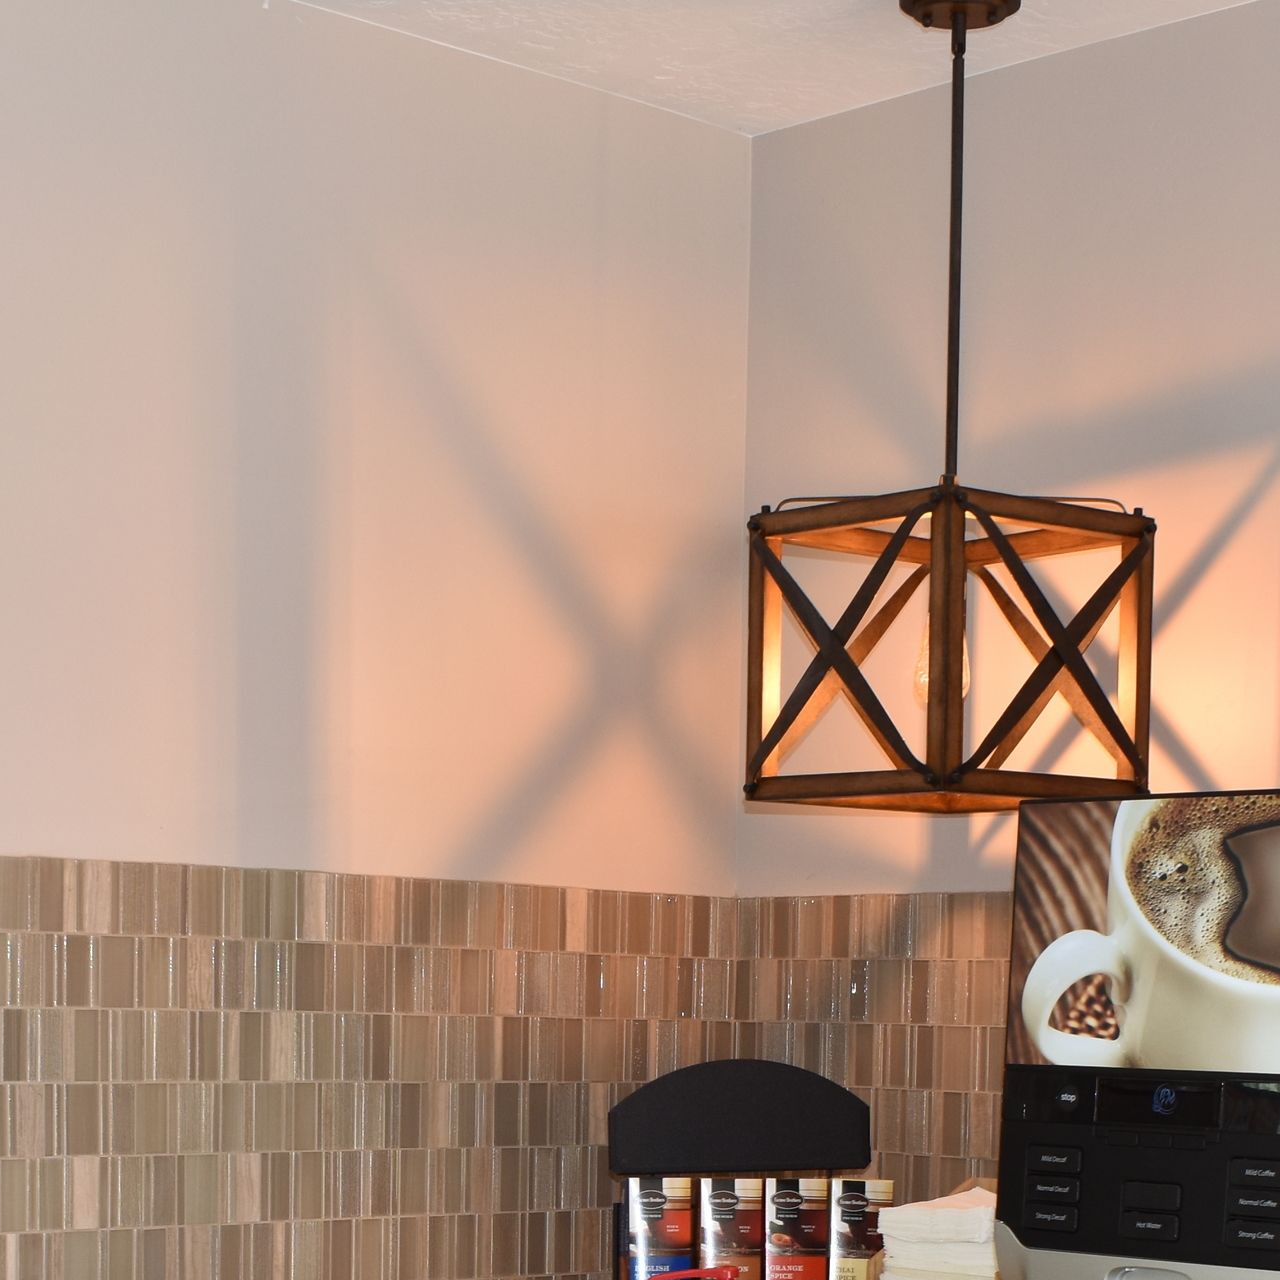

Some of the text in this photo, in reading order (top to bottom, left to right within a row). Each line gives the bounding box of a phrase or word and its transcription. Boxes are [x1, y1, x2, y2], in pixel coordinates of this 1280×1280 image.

[1060, 1093, 1076, 1103] stop
[1052, 1155, 1067, 1163] Decaf
[1258, 1169, 1276, 1177] Coffee
[1036, 1184, 1070, 1193] Normal Decaf
[1239, 1198, 1278, 1207] Normal Coffee
[1035, 1211, 1067, 1221] Strong Decaf
[1238, 1230, 1275, 1240] Strong Coffee
